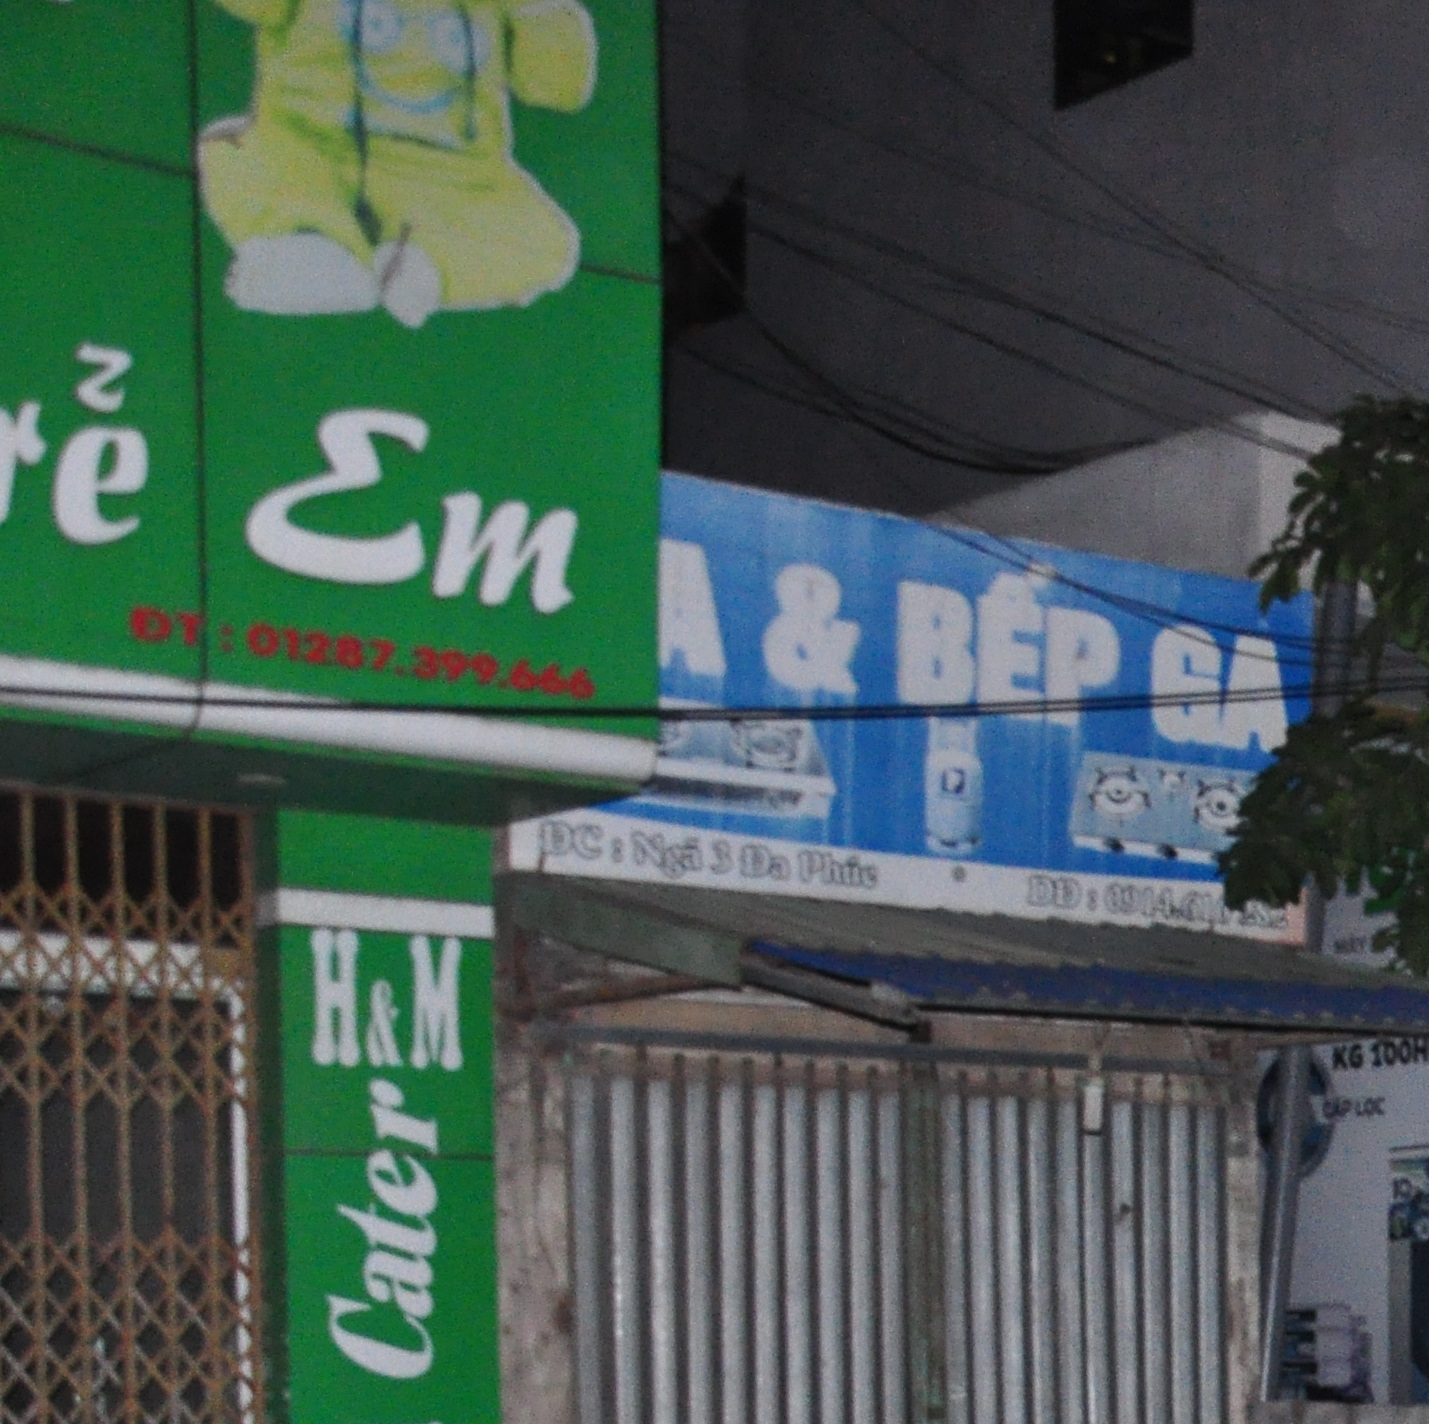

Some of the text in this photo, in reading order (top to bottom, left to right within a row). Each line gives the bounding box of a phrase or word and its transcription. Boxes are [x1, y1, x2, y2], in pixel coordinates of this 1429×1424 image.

[243, 408, 578, 615] Em
[245, 621, 597, 700] 01287.399.666
[761, 563, 861, 695] &
[310, 927, 463, 1073] H&M
[327, 1077, 439, 1379] Cater
